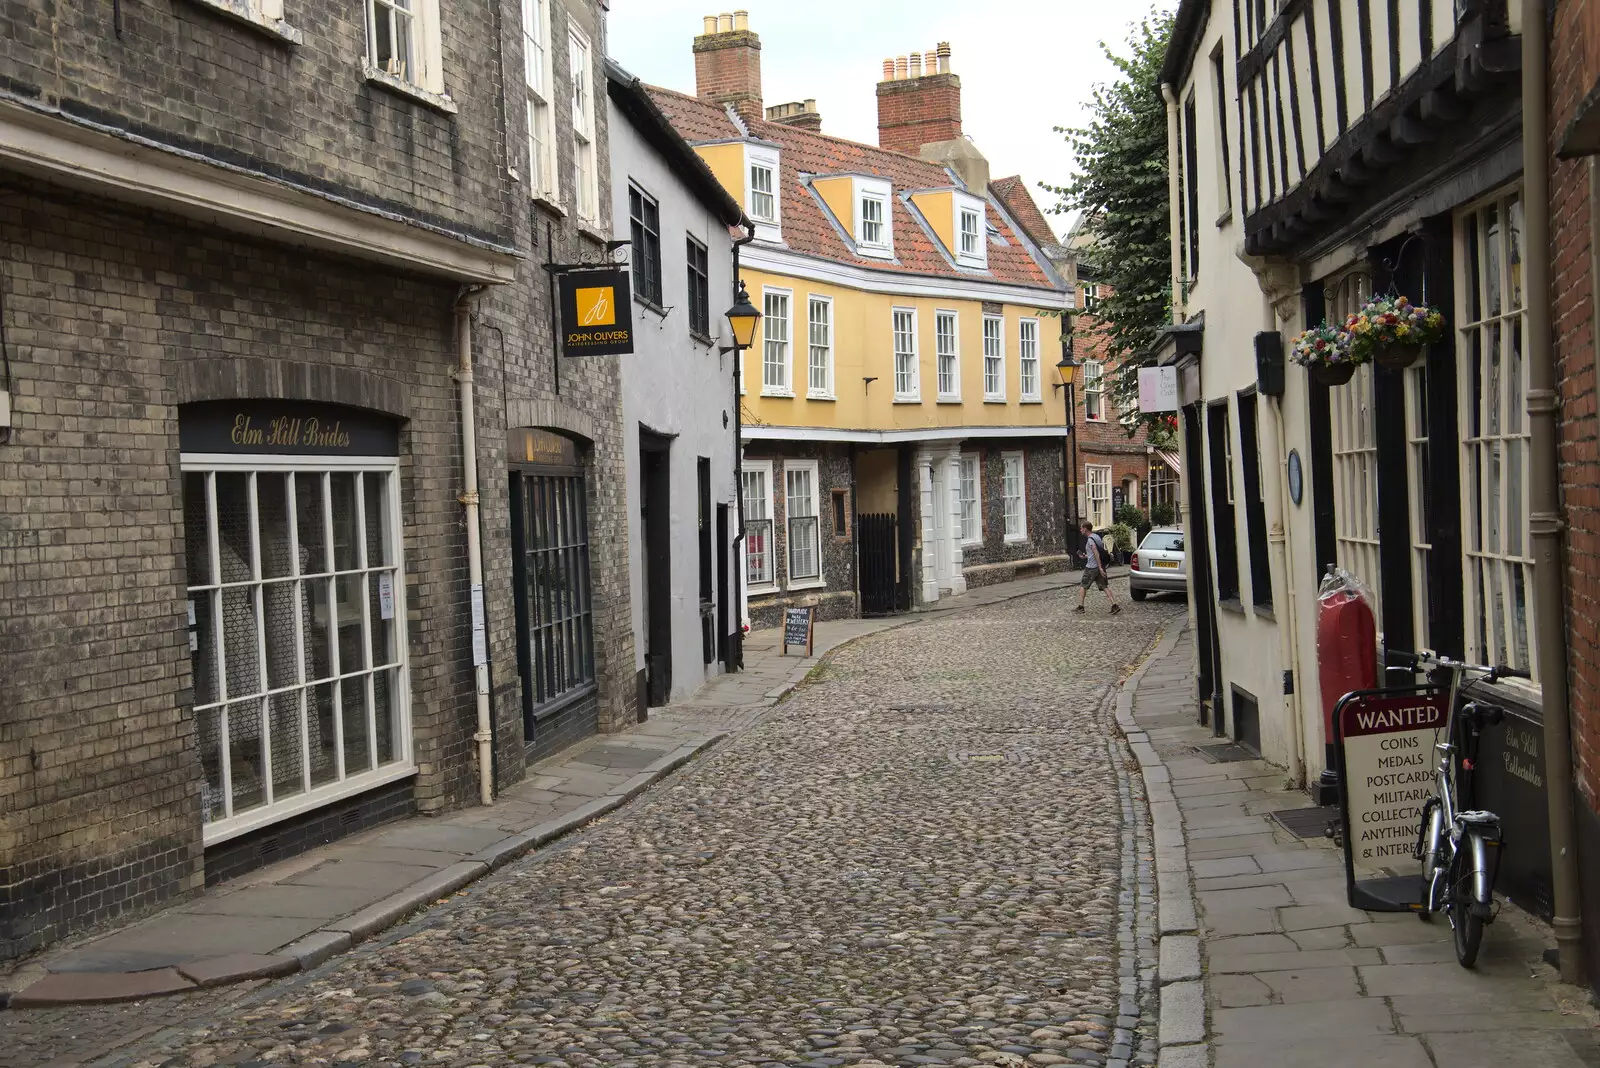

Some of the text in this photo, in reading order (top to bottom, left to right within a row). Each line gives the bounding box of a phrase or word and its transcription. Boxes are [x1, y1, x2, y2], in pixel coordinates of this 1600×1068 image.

[567, 330, 628, 343] JOHN OLIVERS
[231, 413, 350, 447] Elm Hill Brides
[1356, 706, 1439, 730] WANTED
[1380, 737, 1419, 751] COINS
[1505, 726, 1537, 758] Elm Hill
[1378, 753, 1424, 769] MEDALS
[1366, 770, 1436, 788] POSTCARDS
[1373, 789, 1432, 805] MILITARIA
[1362, 807, 1424, 823] COLLECTA
[1362, 848, 1373, 859] &
